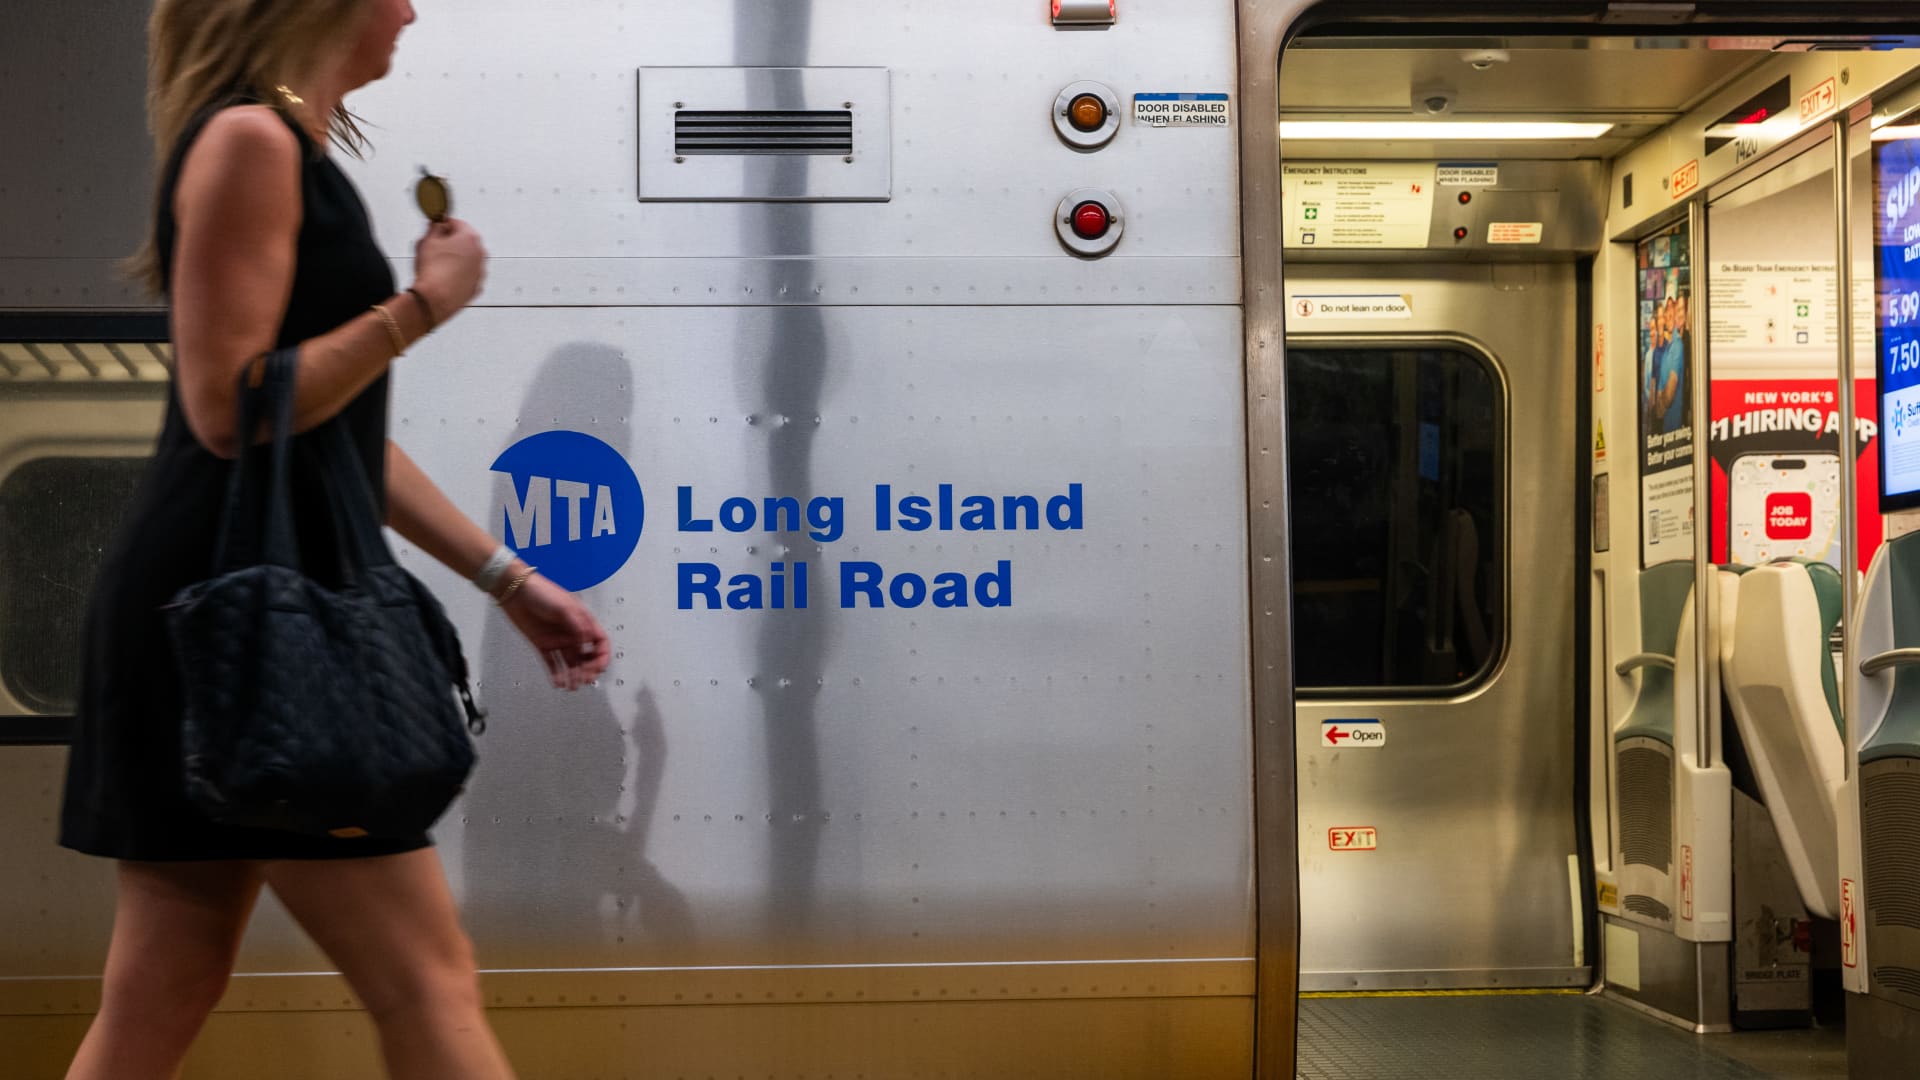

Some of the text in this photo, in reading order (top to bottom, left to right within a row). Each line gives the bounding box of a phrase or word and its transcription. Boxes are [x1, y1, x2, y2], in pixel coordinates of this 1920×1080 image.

[1138, 103, 1226, 113] DOOR DISABLED
[1800, 89, 1821, 118] EXIT
[1137, 115, 1226, 124] WHEN FLASHING
[1283, 165, 1367, 175] EMERGENCY INSTRUCTIONS
[1680, 165, 1696, 187] EXIT
[1321, 304, 1333, 312] Do
[1335, 304, 1350, 312] not
[1352, 304, 1370, 312] lean
[1385, 303, 1406, 312] door
[1889, 290, 1919, 327] 5.99
[1890, 339, 1920, 375] 7.50
[1745, 391, 1834, 404] NEW YORK'S
[1732, 407, 1823, 438] HIRING
[1824, 411, 1878, 443] AP
[490, 469, 617, 550] MTA
[677, 483, 1084, 543] Long Island
[1770, 505, 1794, 516] JOB
[1769, 516, 1808, 527] TODAY
[677, 560, 1012, 610] Rail Road
[1352, 729, 1383, 742] Open
[1331, 831, 1374, 847] EXIT
[1842, 882, 1853, 963] EXIT
